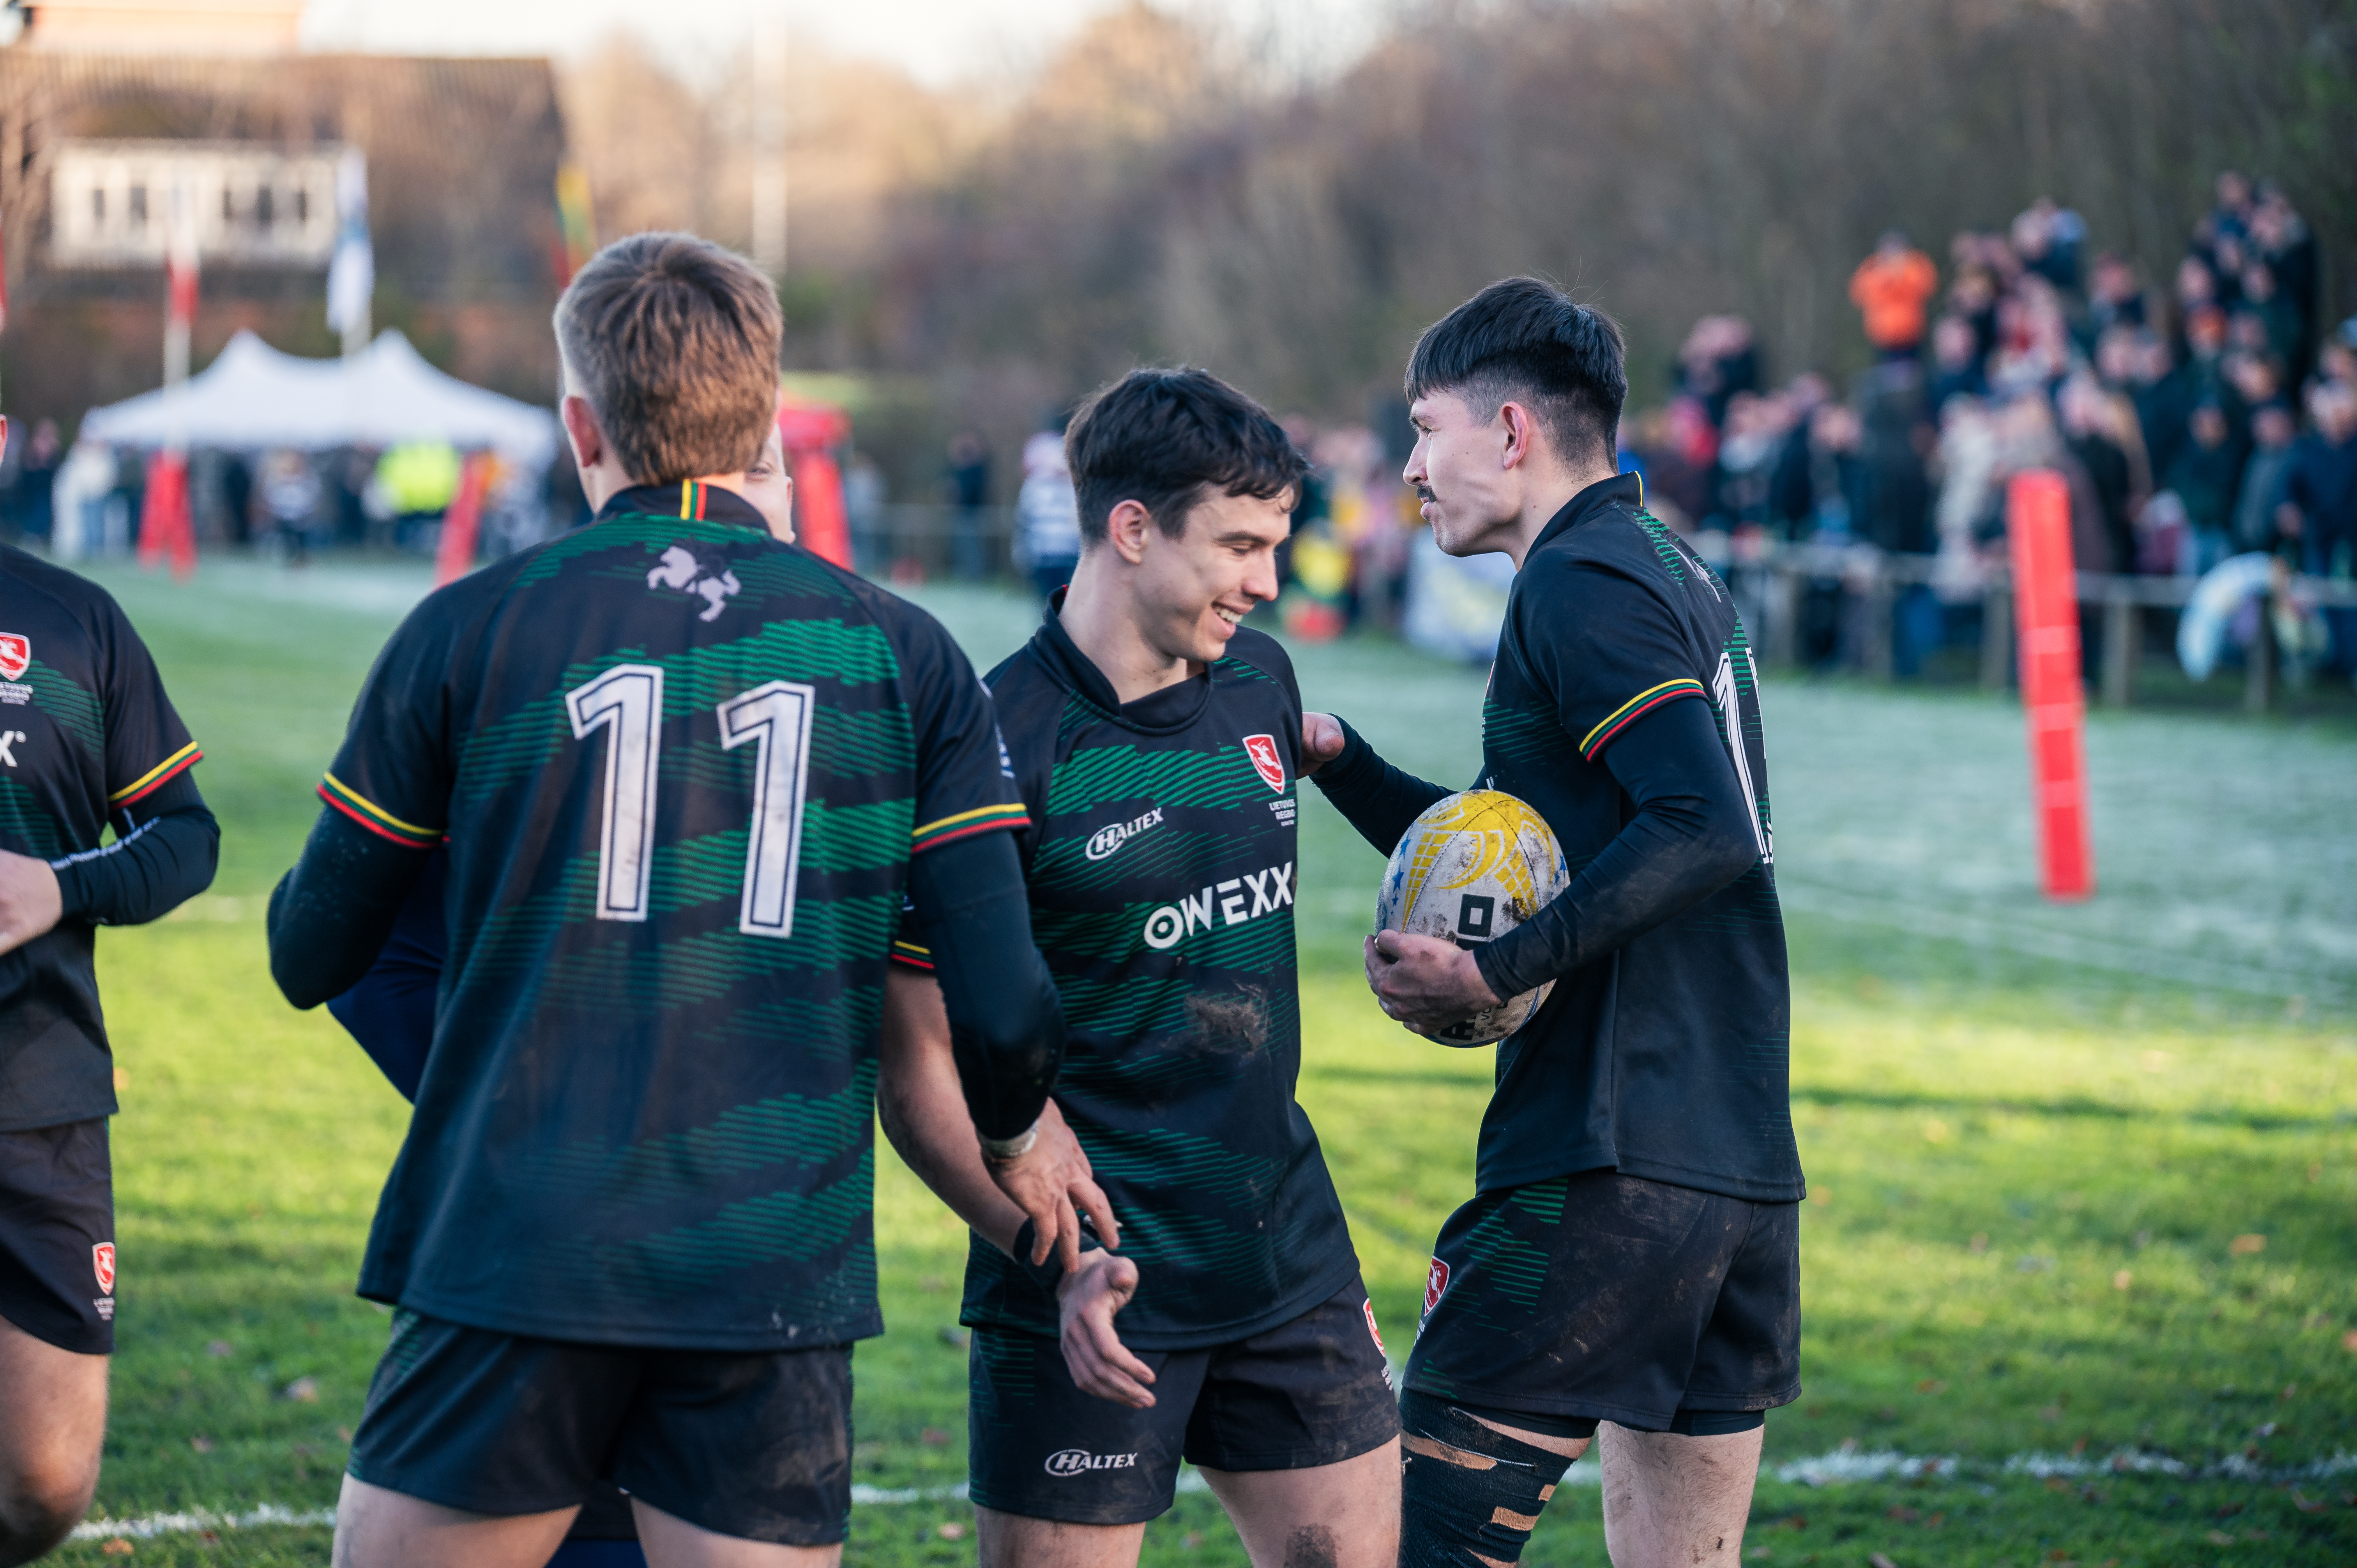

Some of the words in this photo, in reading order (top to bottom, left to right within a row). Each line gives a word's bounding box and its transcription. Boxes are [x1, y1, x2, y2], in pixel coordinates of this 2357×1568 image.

[565, 663, 815, 939] 11
[1094, 807, 1164, 853] HALTEX
[1143, 861, 1293, 949] OWEXX
[1053, 1451, 1140, 1470] HALTEX
